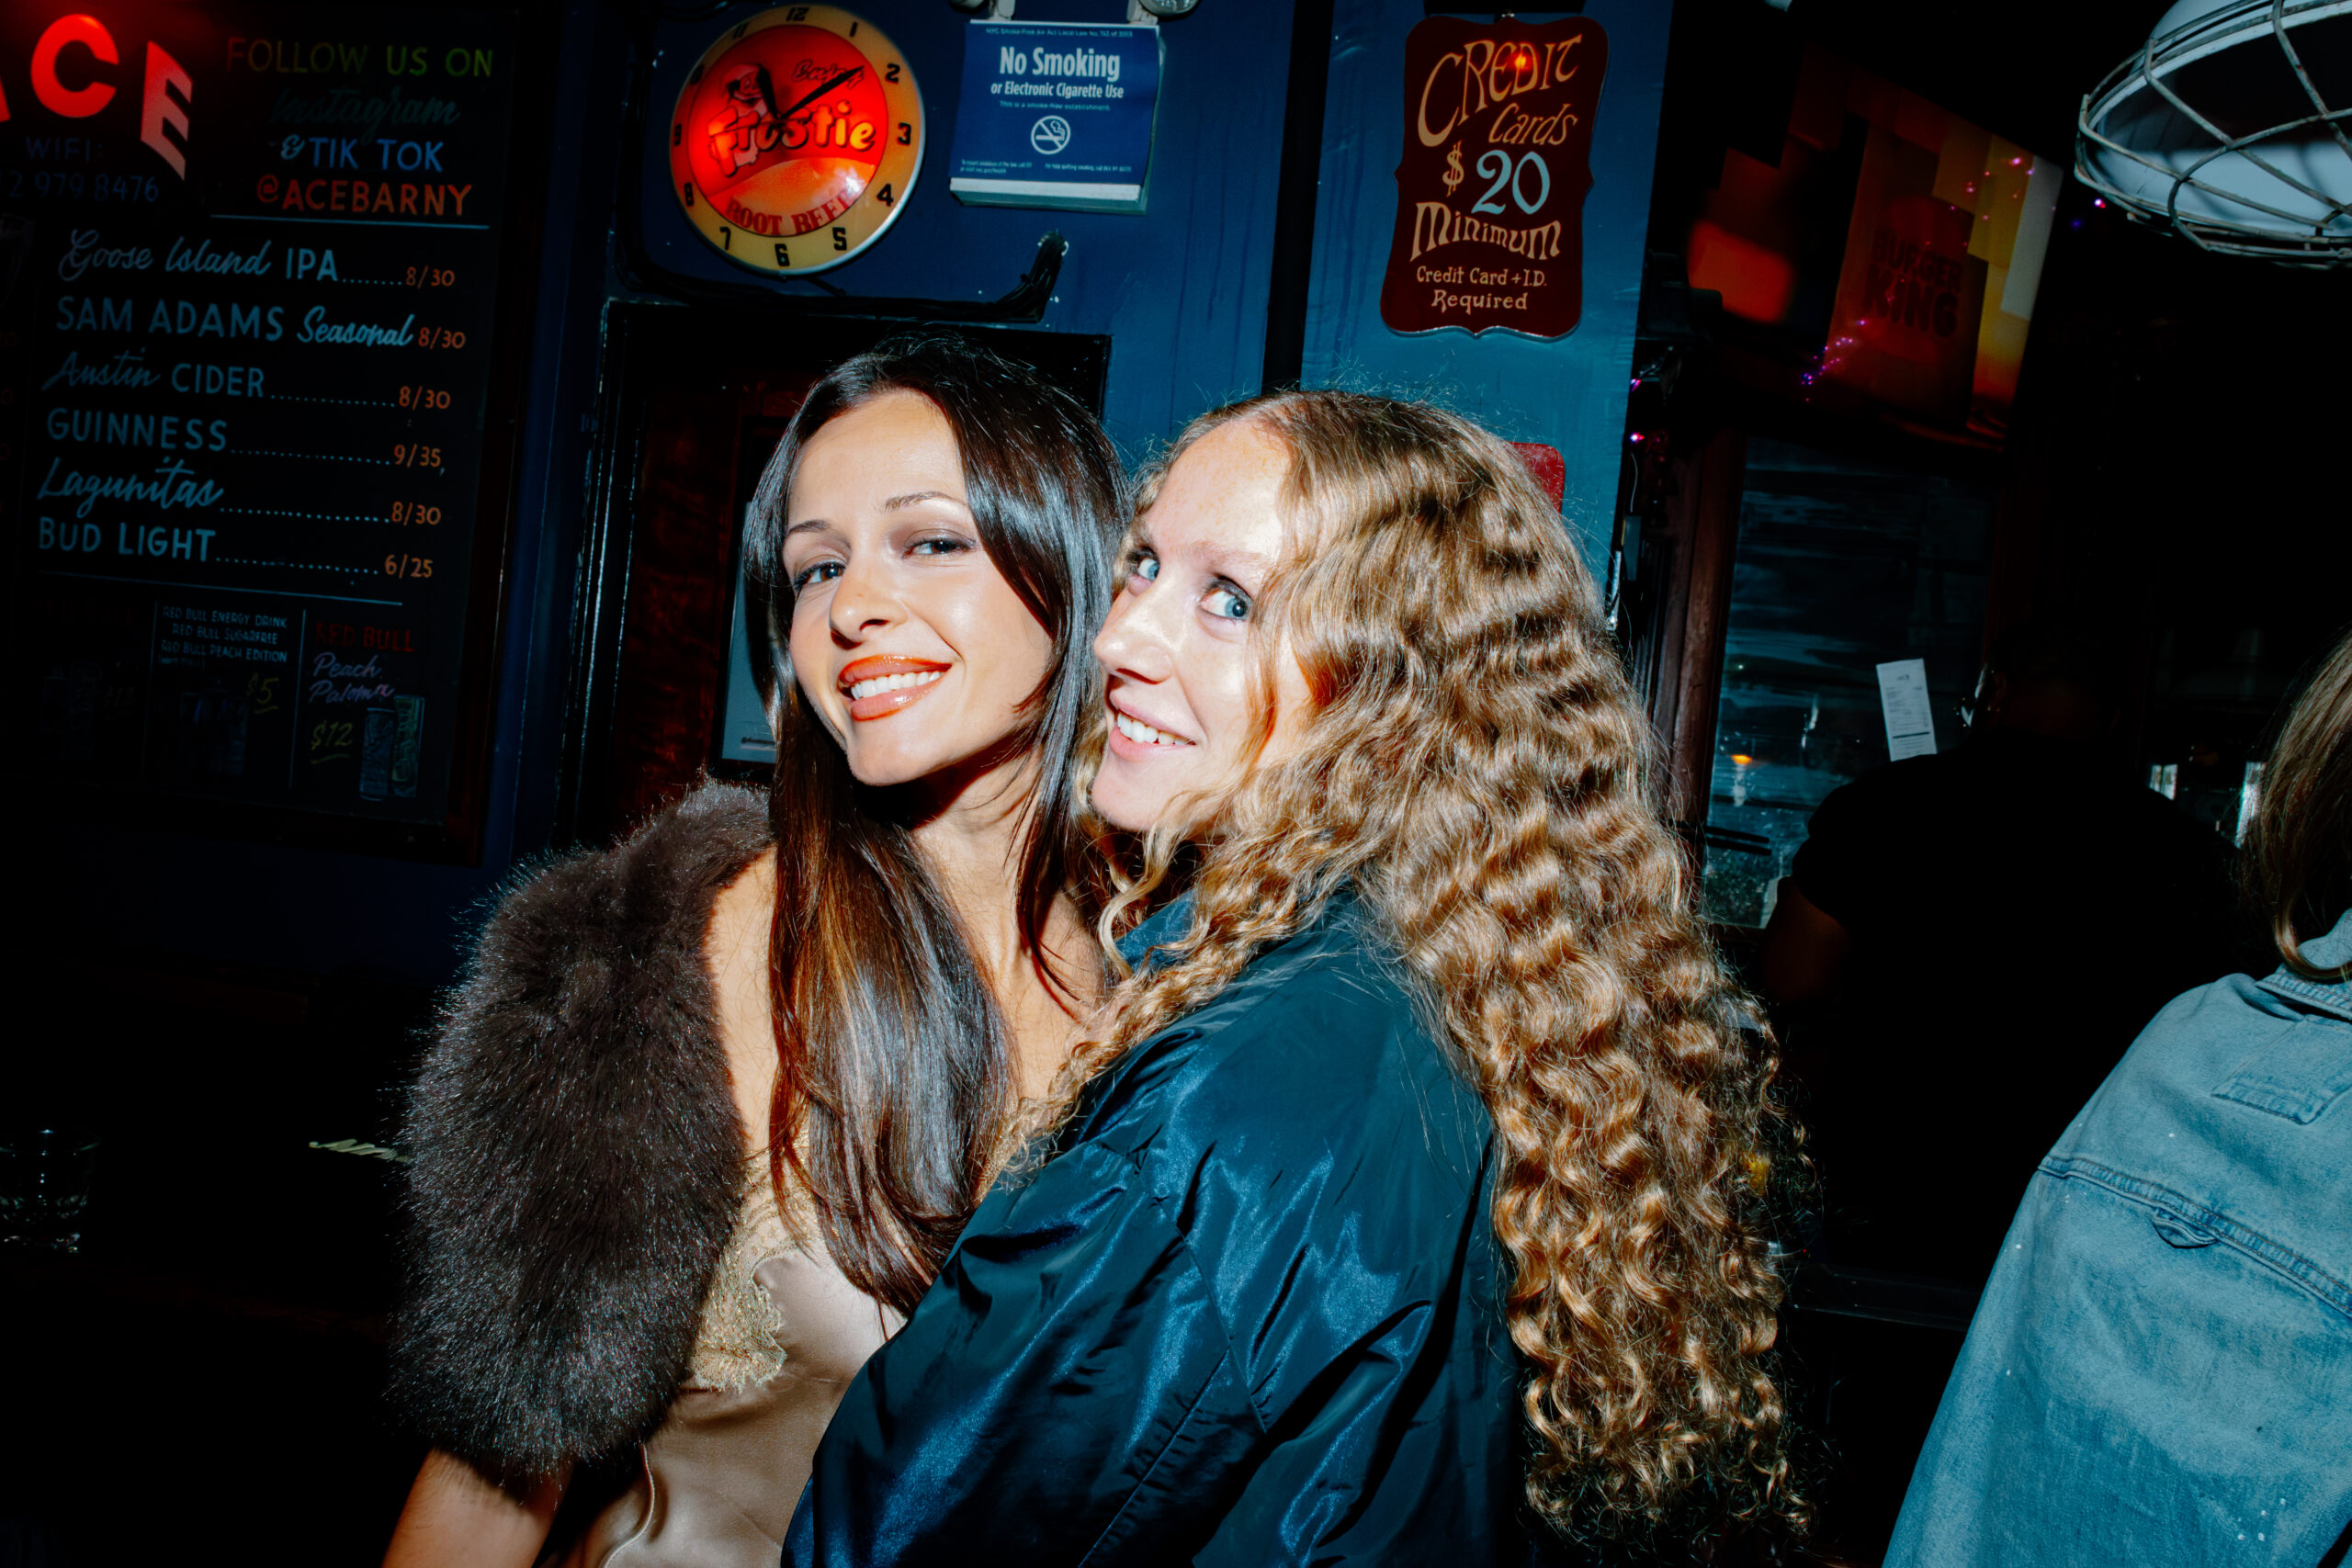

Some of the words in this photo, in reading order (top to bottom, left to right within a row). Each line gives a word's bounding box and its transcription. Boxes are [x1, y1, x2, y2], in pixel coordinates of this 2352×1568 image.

[786, 7, 809, 22] 12
[849, 21, 858, 38] 1
[227, 38, 368, 74] FOLLOW
[386, 44, 429, 77] US
[444, 47, 493, 78] ON
[885, 62, 900, 85] 2
[1000, 46, 1026, 75] No
[1033, 47, 1120, 83] Smoking
[0, 14, 193, 181] CE
[990, 84, 1002, 95] or
[1004, 81, 1054, 96] Electronic
[1057, 83, 1102, 99] Cigarette
[1105, 85, 1124, 98] Use
[1418, 33, 1582, 147] CREDIT
[268, 82, 461, 145] Instagram
[1487, 102, 1579, 146] Cards
[25, 135, 104, 163] WIFI:
[707, 98, 876, 178] Frostie
[898, 121, 911, 145] 3
[375, 138, 445, 174] TOK
[34, 170, 85, 199] 979
[93, 172, 161, 204] 8476
[254, 172, 474, 217] @ACEBARNY
[876, 183, 894, 207] 4
[726, 197, 782, 236] ROOT
[719, 226, 731, 251] 7
[775, 243, 790, 266] 6
[831, 227, 847, 251] 5
[58, 228, 154, 282] Goose
[164, 235, 272, 276] Island
[285, 245, 339, 282] IPA
[405, 265, 456, 289] 8/30
[1871, 228, 1963, 293] BURGER
[1417, 265, 1464, 285] Credit
[1469, 266, 1509, 287] Card
[1431, 289, 1529, 315] Required
[1863, 265, 1959, 338] KING
[55, 294, 133, 334] SAM
[147, 297, 286, 343] ADAMS
[296, 304, 415, 347] Seasonal
[417, 325, 467, 350] 8/30
[40, 345, 162, 392] Austin
[170, 362, 265, 398] CIDER
[398, 384, 452, 411] 8/30
[46, 406, 229, 452] GUINNESS
[393, 443, 442, 468] 9/35
[37, 455, 225, 520] Lagunitas
[390, 501, 442, 526] 8/30
[38, 515, 103, 555] BUD
[117, 521, 218, 562] LIGHT
[383, 553, 434, 580] 6/25
[162, 605, 183, 620] RED
[210, 610, 251, 626] ENERGY
[254, 614, 288, 630] DRINK
[171, 622, 194, 637] RED
[209, 643, 243, 659] PEACH
[245, 648, 288, 663] EDITION
[316, 621, 356, 647] RED
[362, 625, 415, 654] BULL
[312, 651, 382, 679] Peach
[309, 679, 396, 705] Paloma
[311, 720, 354, 750] $12
